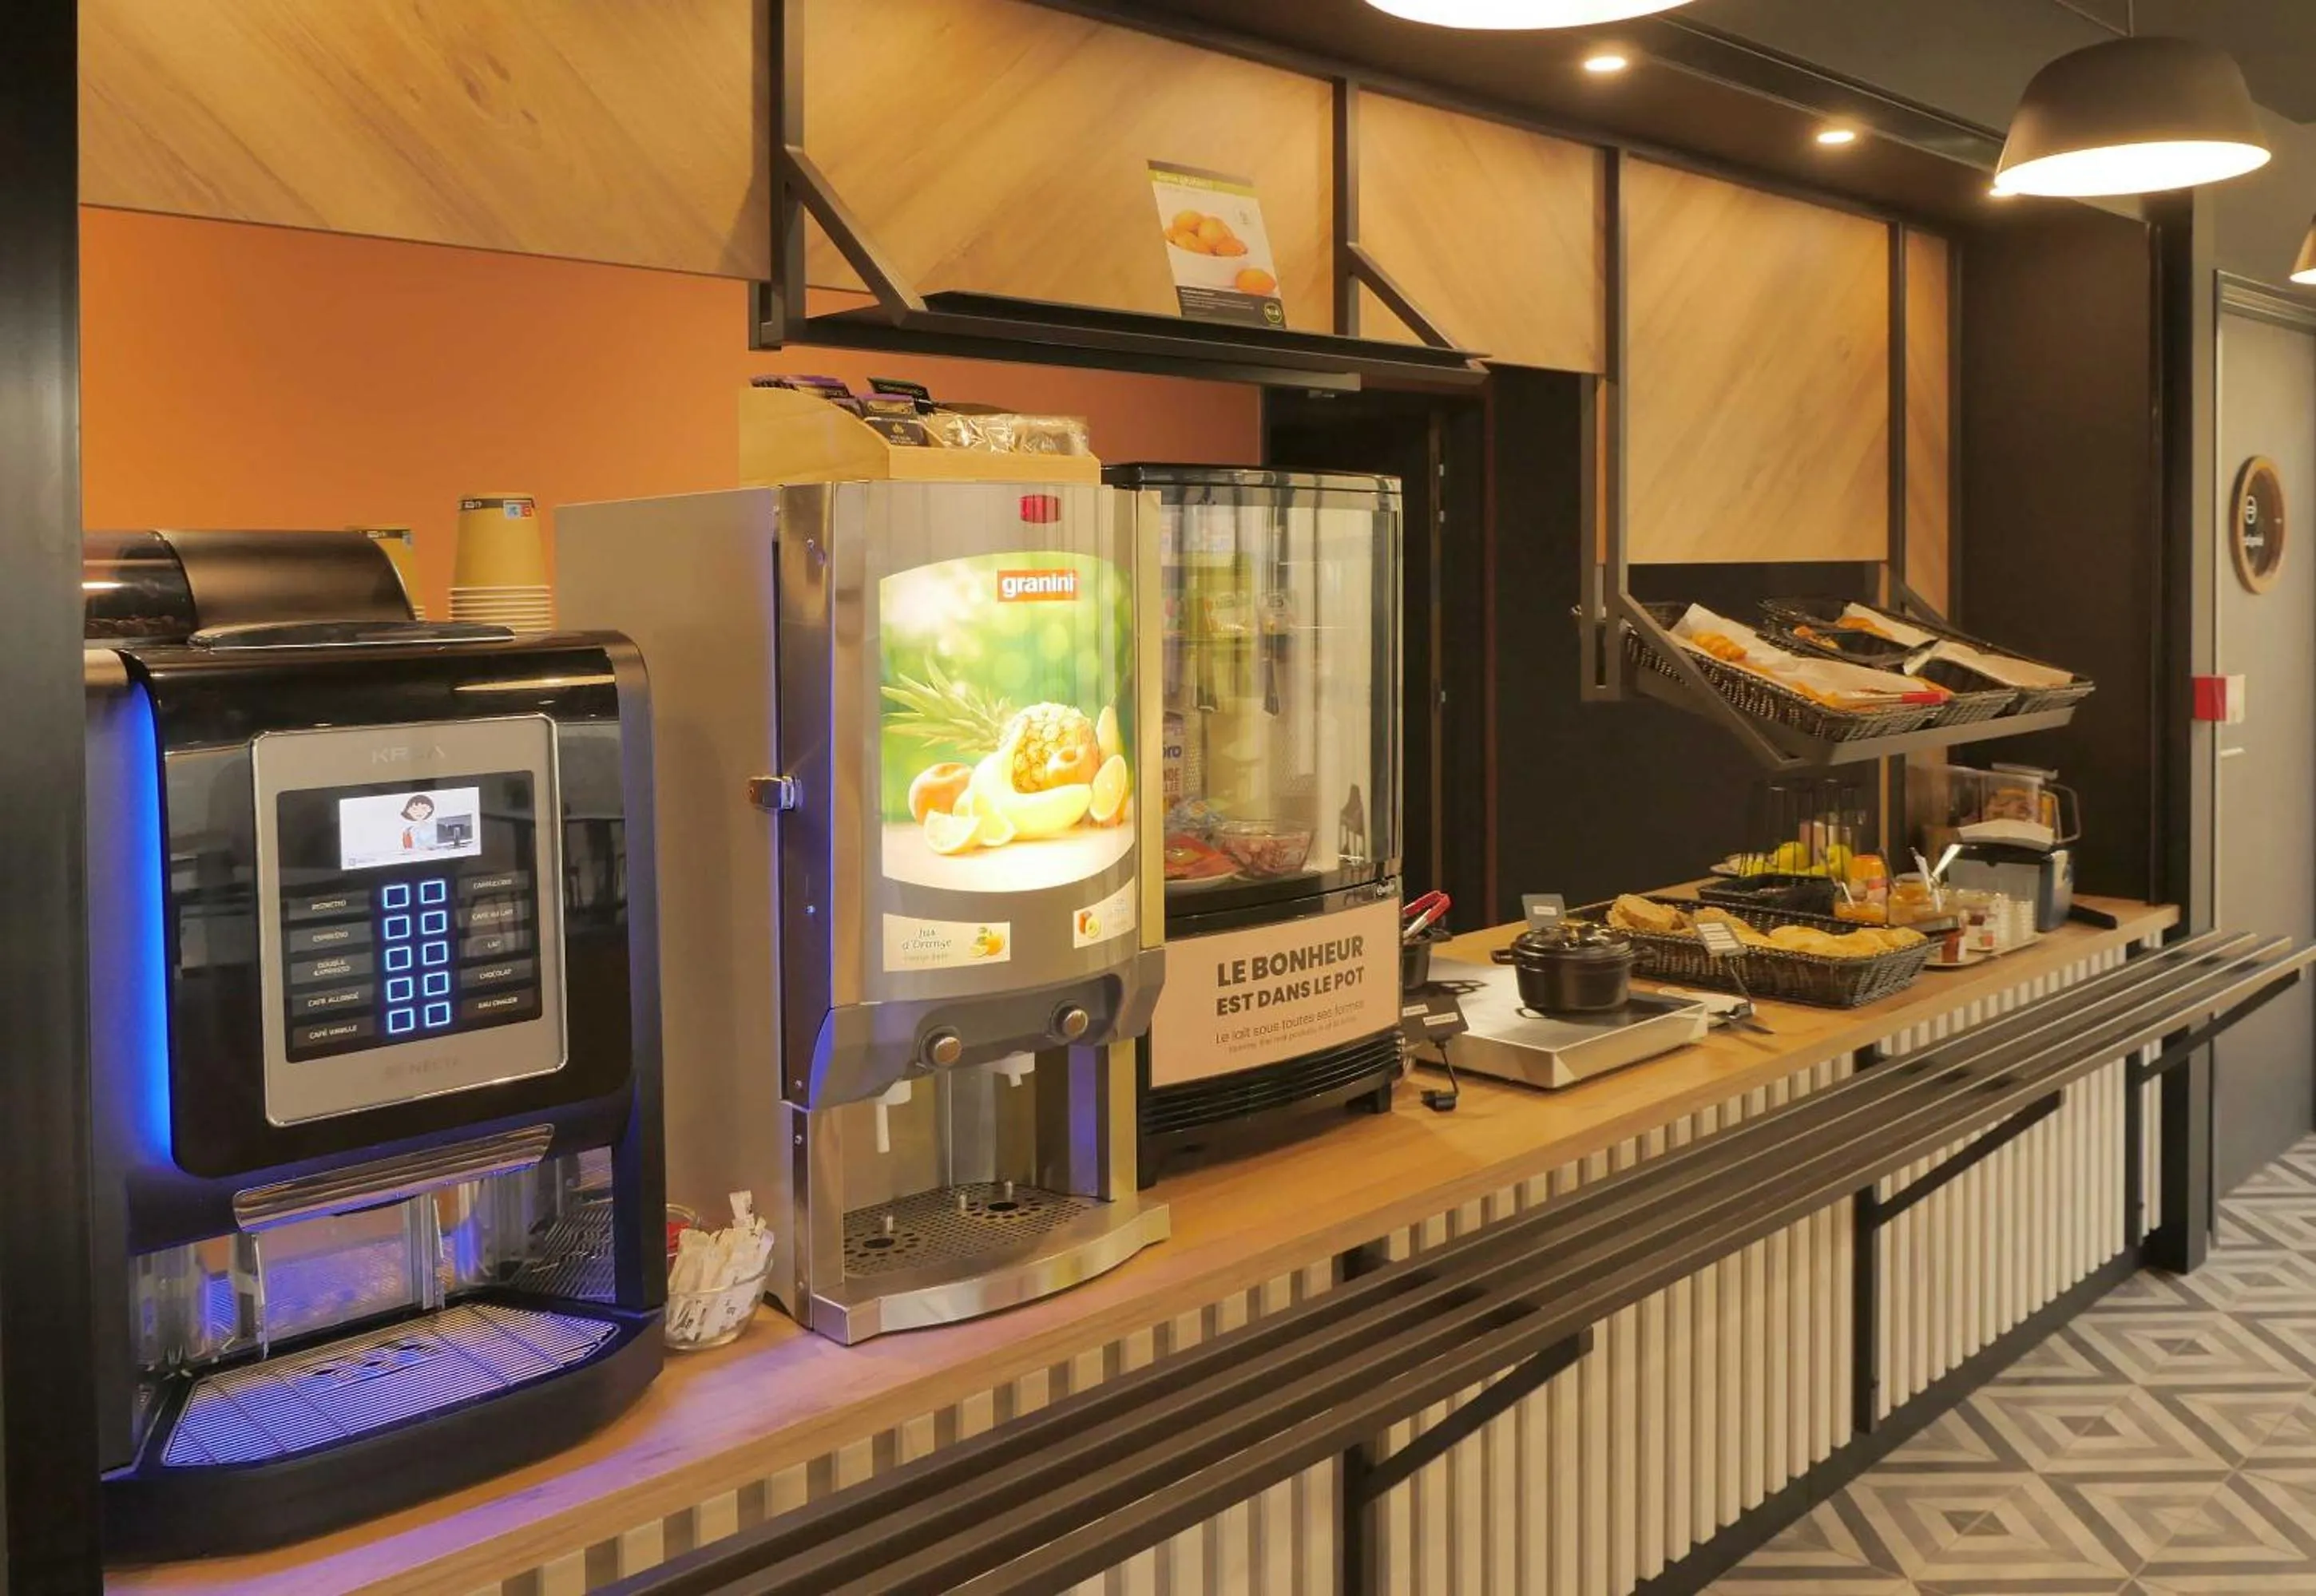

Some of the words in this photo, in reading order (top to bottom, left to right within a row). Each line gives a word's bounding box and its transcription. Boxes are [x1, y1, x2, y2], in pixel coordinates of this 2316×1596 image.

[1001, 573, 1074, 598] granini
[372, 745, 446, 764] KRA
[1217, 960, 1246, 988] LE
[1251, 935, 1364, 981] BONHEUR
[1216, 992, 1254, 1016] EST
[1258, 980, 1311, 1008] DANS
[1315, 975, 1331, 995] LE
[1334, 966, 1365, 990] POT
[1216, 1032, 1230, 1044] Le
[1233, 1028, 1251, 1040] lait
[1253, 1023, 1279, 1037] sous
[1282, 1015, 1314, 1030] toutes
[1317, 1009, 1333, 1022] ses
